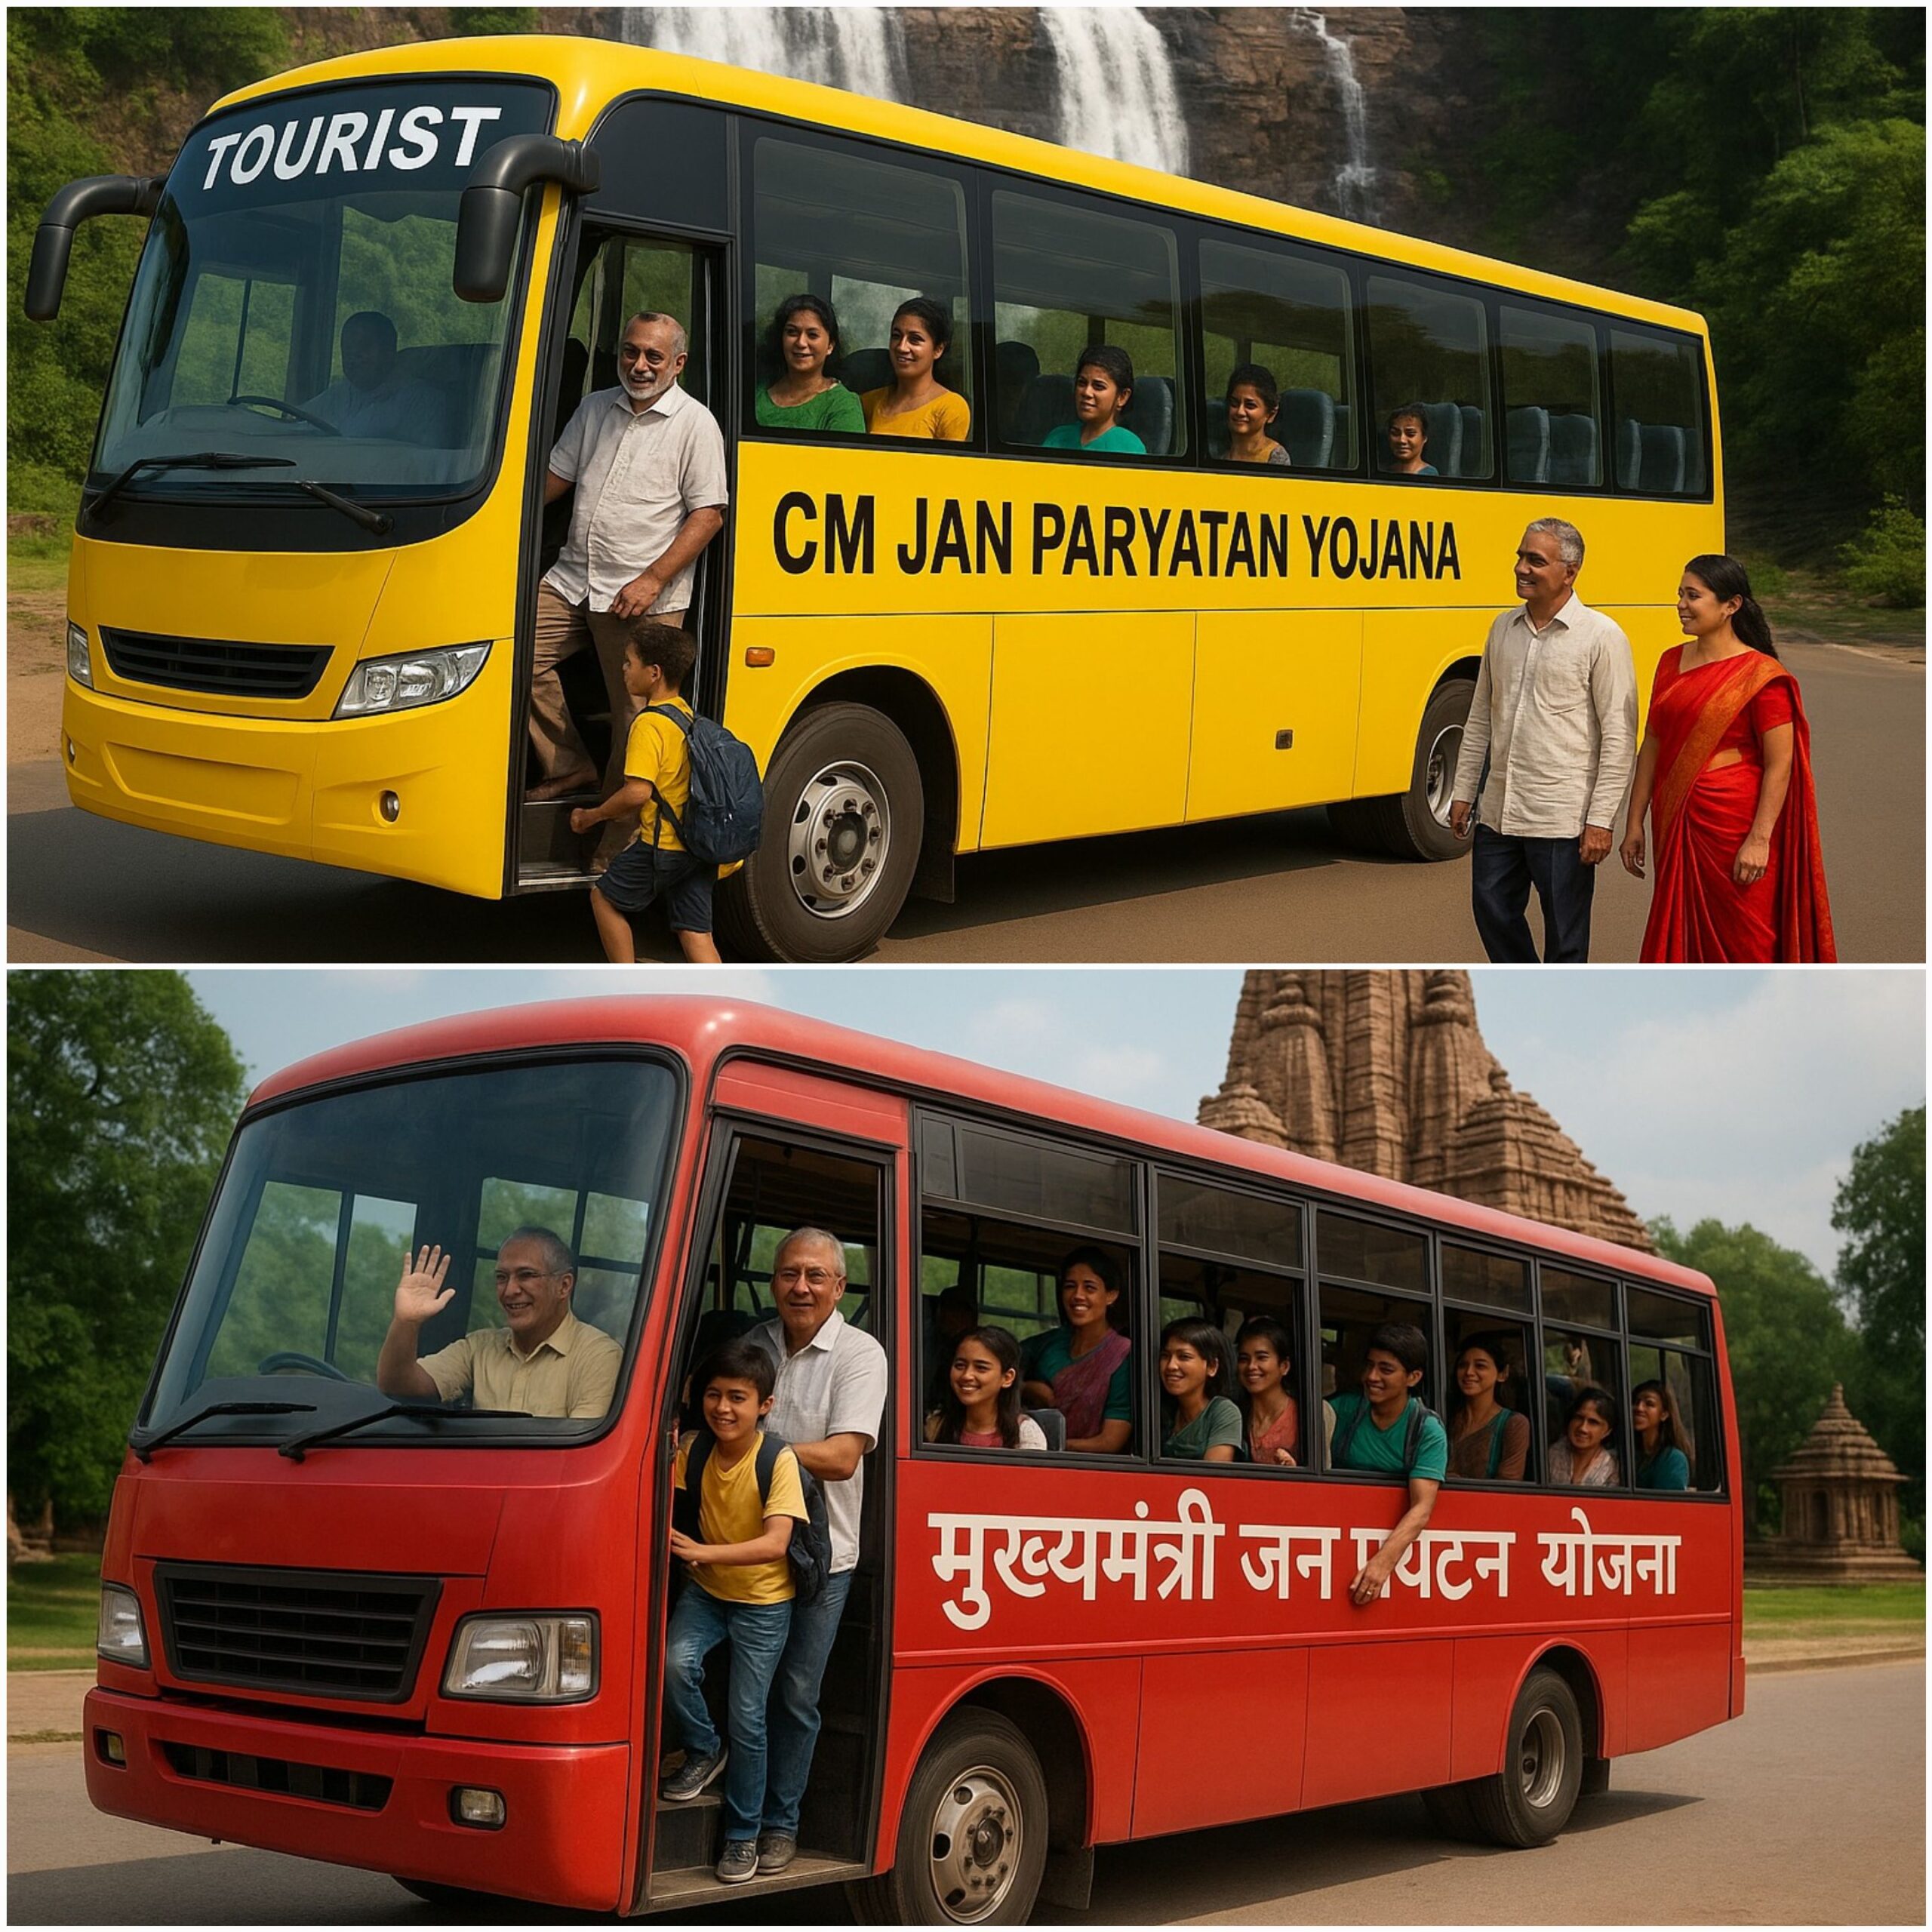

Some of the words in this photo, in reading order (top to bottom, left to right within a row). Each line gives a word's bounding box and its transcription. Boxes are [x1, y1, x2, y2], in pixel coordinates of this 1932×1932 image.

[203, 106, 502, 190] TOURIST
[774, 491, 875, 575] CM
[897, 497, 1012, 575] JAN
[1032, 503, 1288, 578] PARYATAN
[1302, 515, 1461, 580] YOJANA
[928, 1488, 1226, 1631] मुख्यमंत्री
[1238, 1524, 1341, 1599] जन
[1537, 1507, 1681, 1596] योजना
